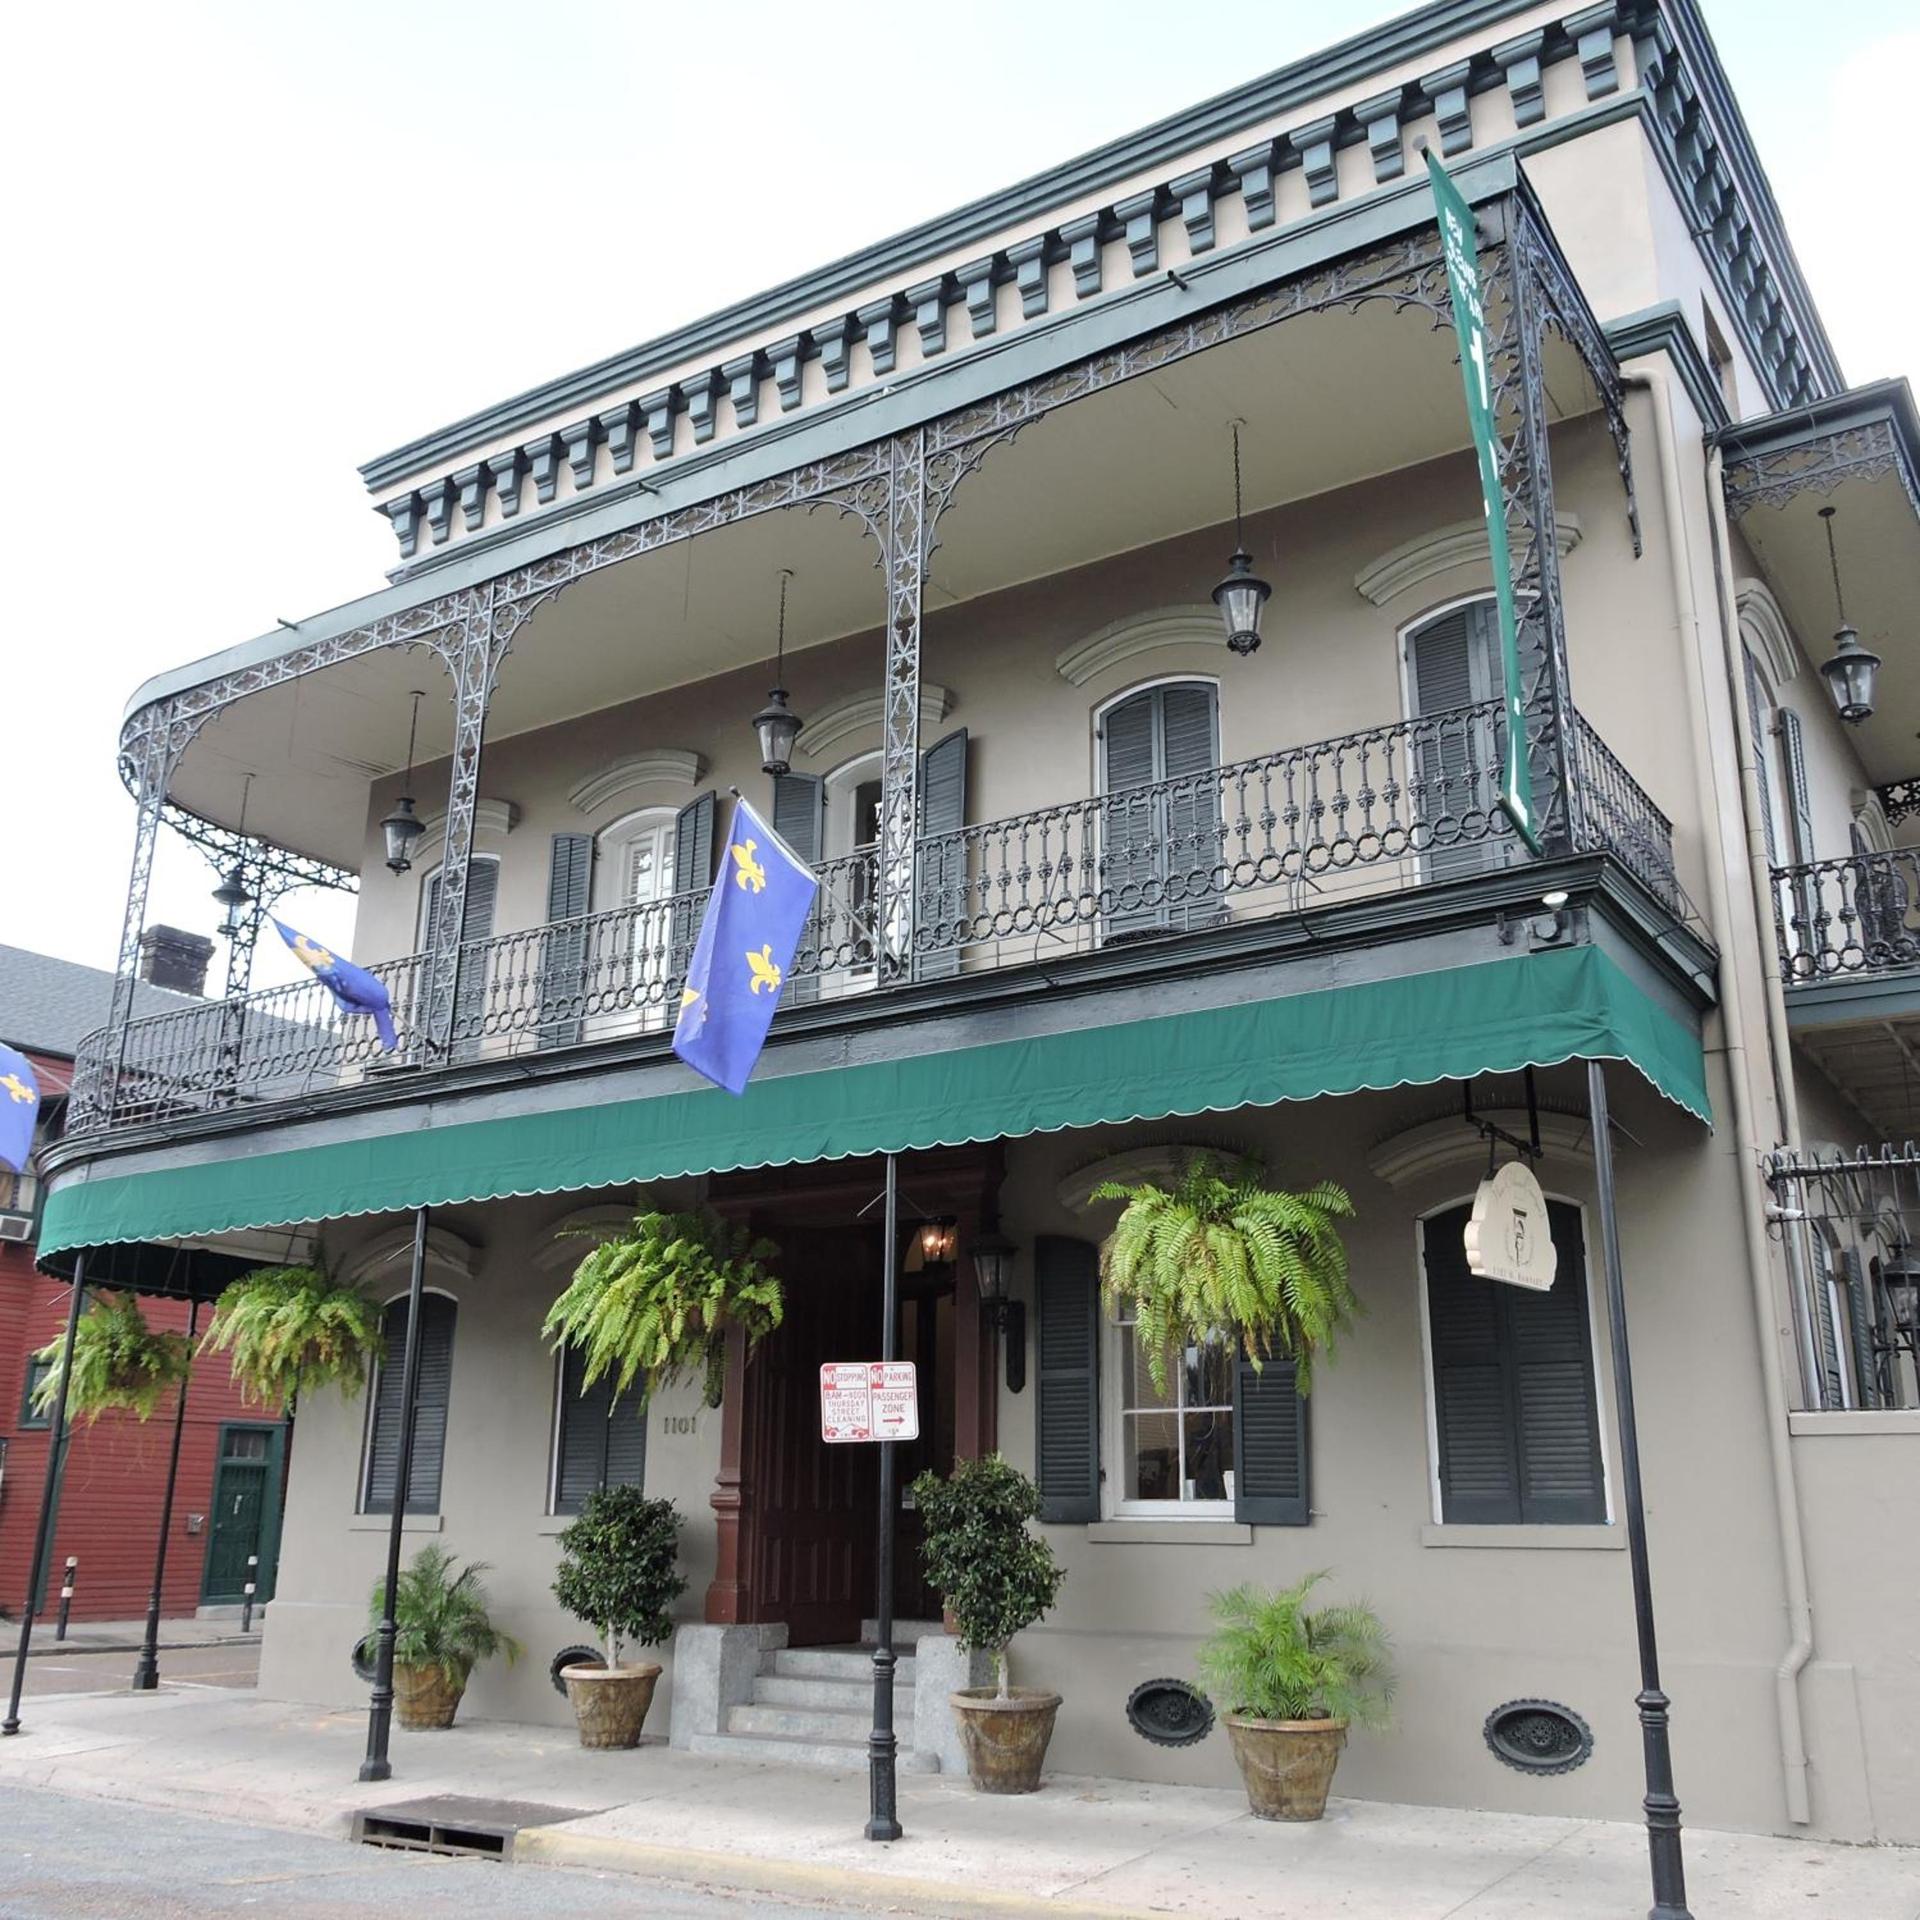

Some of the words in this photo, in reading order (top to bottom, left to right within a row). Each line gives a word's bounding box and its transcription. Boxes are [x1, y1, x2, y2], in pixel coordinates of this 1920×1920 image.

[823, 1369, 836, 1385] NO
[836, 1372, 866, 1382] STOPPING
[872, 1368, 883, 1385] NO
[884, 1371, 913, 1382] PARKING
[873, 1391, 913, 1401] PASSENGER
[828, 1400, 865, 1408] THURSDAY
[882, 1404, 905, 1414] ZONE
[832, 1407, 860, 1415] STREET
[826, 1415, 866, 1423] CLEANING
[664, 1416, 696, 1434] 1101
